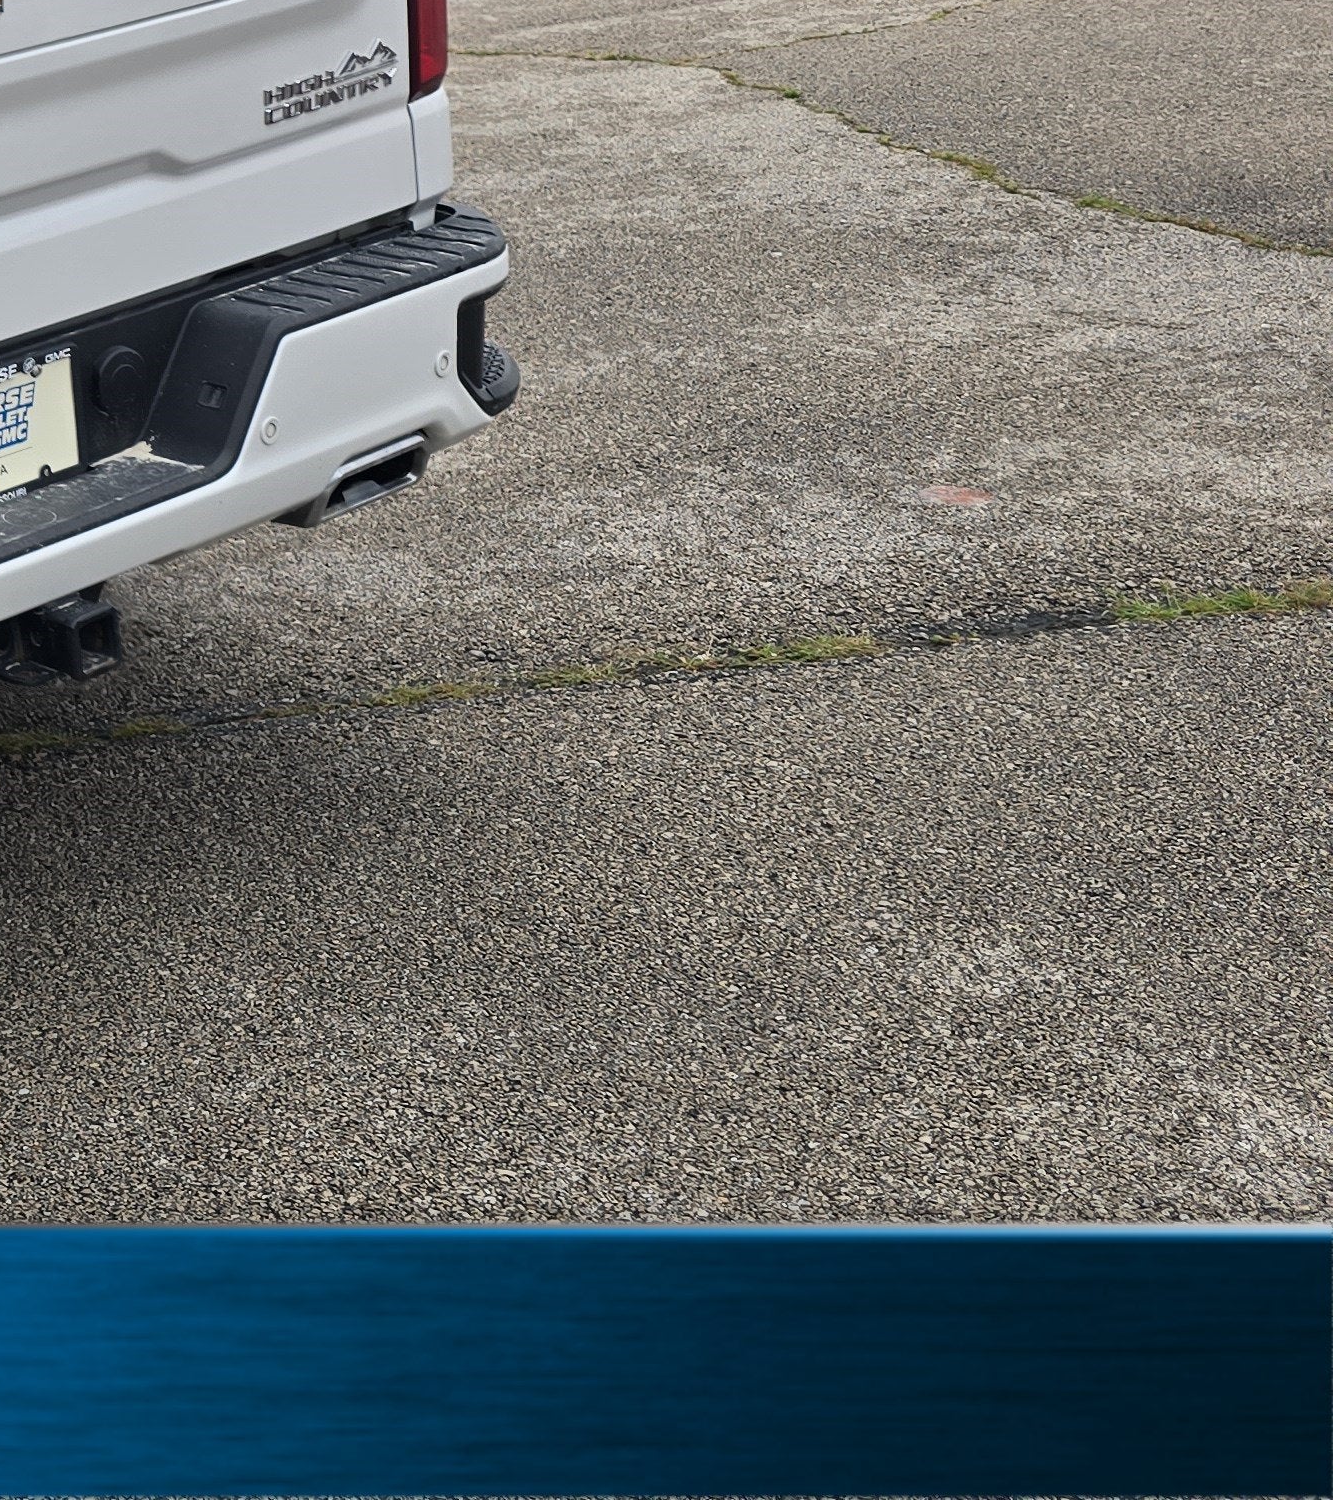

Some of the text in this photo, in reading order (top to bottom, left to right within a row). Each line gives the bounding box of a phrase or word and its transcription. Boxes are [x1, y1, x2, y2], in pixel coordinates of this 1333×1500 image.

[263, 70, 335, 107] HIGH
[264, 67, 398, 126] COUNTRY
[44, 347, 72, 364] GMC
